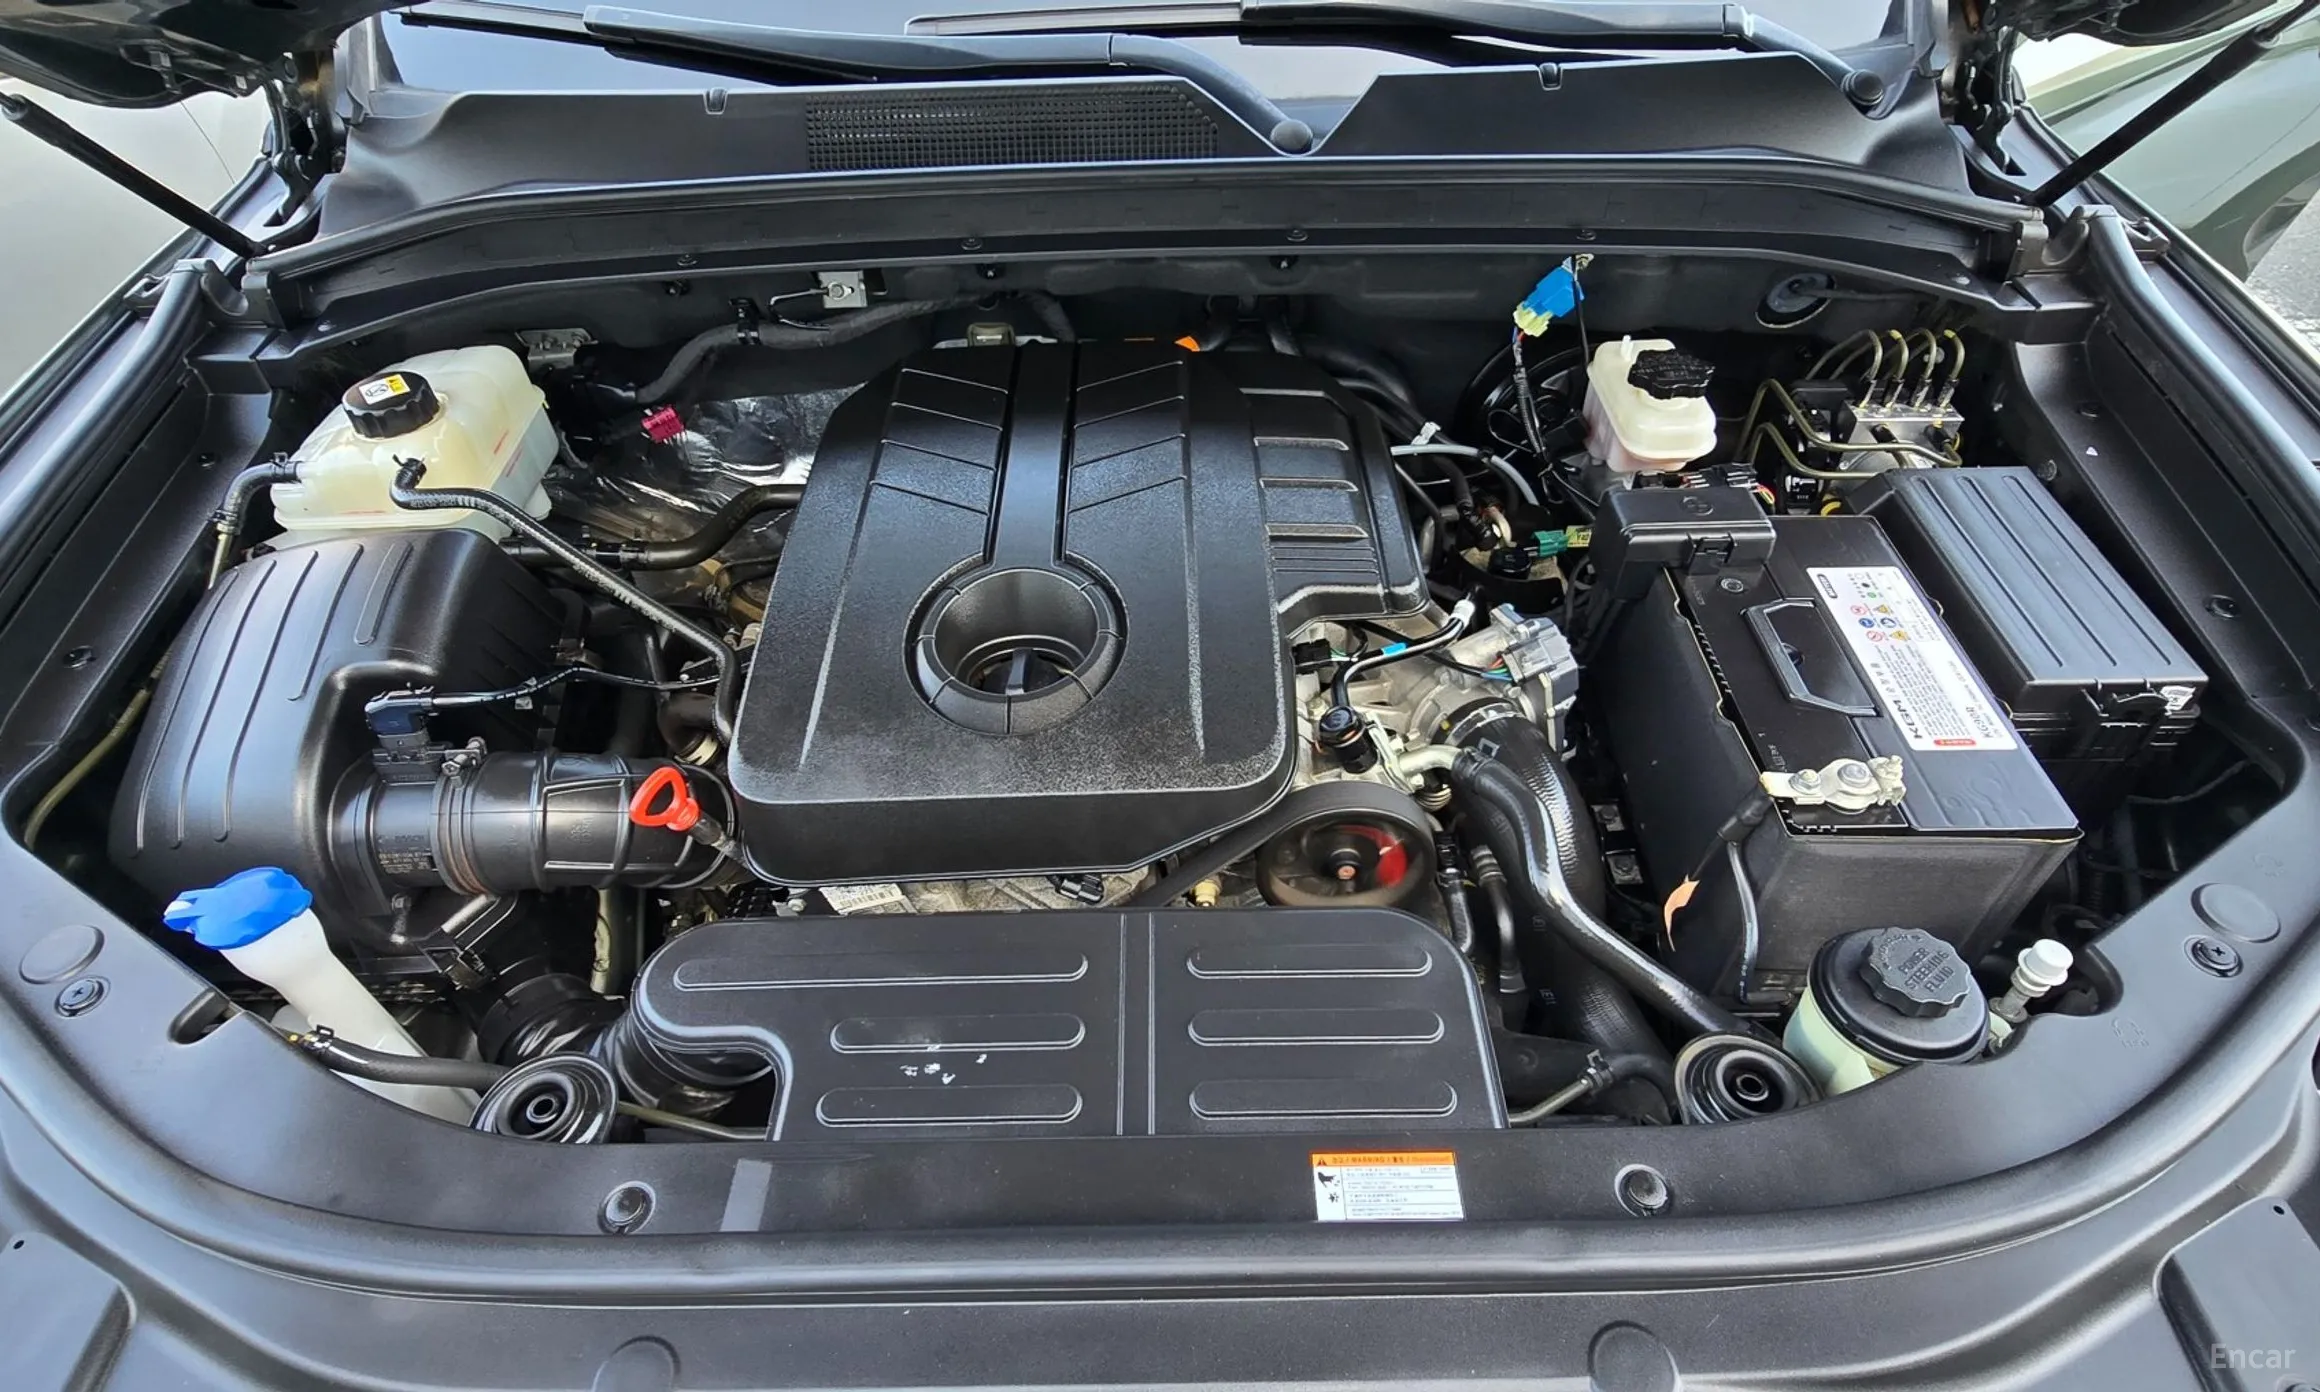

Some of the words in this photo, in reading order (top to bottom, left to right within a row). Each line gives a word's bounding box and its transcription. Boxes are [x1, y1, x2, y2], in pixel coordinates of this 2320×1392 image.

[1898, 947, 1931, 975] POWER
[1904, 951, 1949, 990] STEERING
[1924, 965, 1954, 993] FLUID
